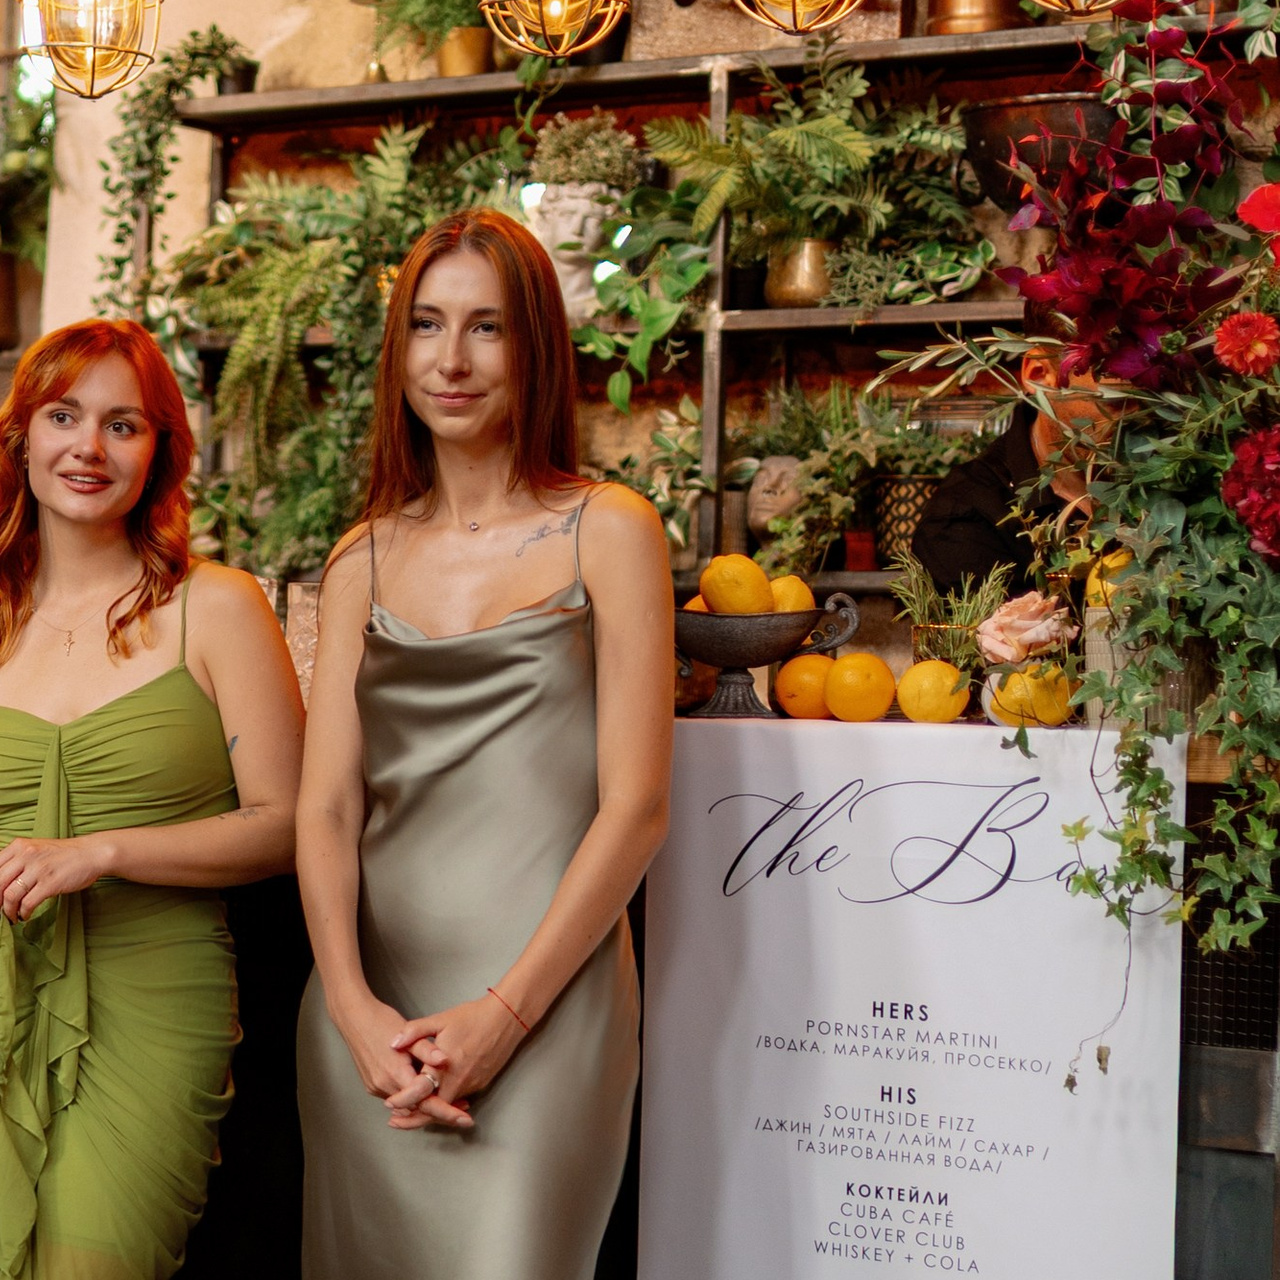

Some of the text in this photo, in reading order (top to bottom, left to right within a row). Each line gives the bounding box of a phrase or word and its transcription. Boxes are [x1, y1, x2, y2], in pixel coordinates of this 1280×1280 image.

[708, 777, 864, 897] the
[871, 1000, 929, 1022] HERS
[806, 1019, 998, 1050] PORNSTAR MARTINI
[755, 1034, 1052, 1076] /ВОДКА, МАРАКУЙЯ, ПРОСЕККО/
[880, 1084, 917, 1106] HIS
[823, 1103, 975, 1133] SOUTHSIDE FIZZ
[754, 1116, 812, 1135] /ДЖИН
[832, 1125, 877, 1143] МЯТА
[898, 1131, 952, 1150] ЛАЙМ
[973, 1139, 1035, 1158] САХАР
[797, 1138, 1003, 1175] ГАЗИРОВАННАЯ ВОДА/
[845, 1181, 949, 1207] КОКТЕЙЛИ
[840, 1201, 954, 1229] CUBA CAFÉ
[828, 1221, 965, 1251] CLOVER CLUB
[813, 1239, 980, 1274] WHISKEY + COLA
